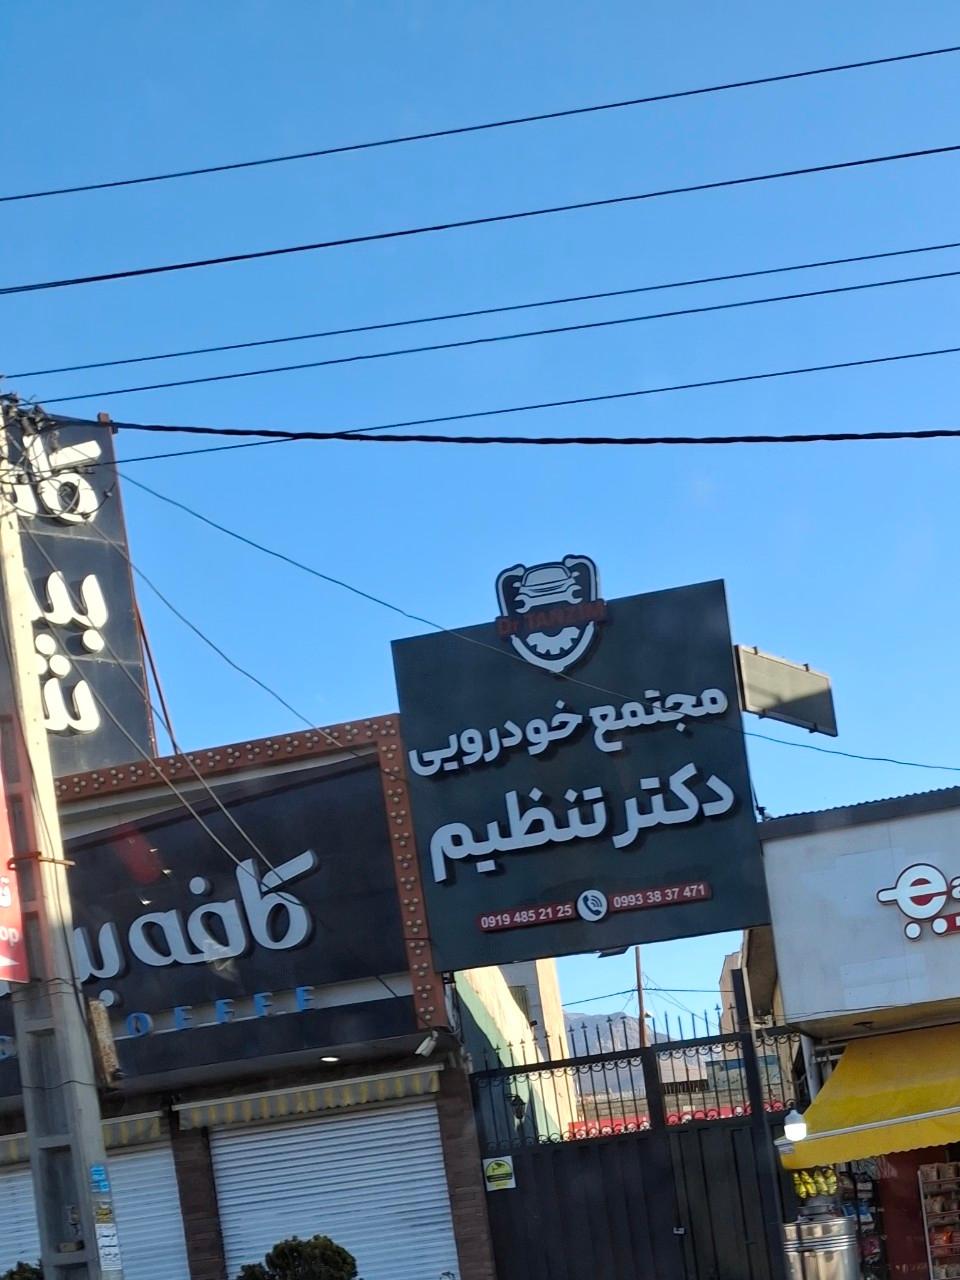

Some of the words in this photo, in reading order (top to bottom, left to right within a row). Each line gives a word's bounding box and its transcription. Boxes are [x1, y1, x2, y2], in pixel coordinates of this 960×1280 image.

[407, 699, 583, 777] خودرویی
[589, 688, 728, 753] مجتمع
[429, 785, 607, 884] تنظیم
[612, 762, 735, 849] دکتر
[481, 913, 510, 929] 0919
[513, 910, 536, 924] 485
[539, 908, 553, 921] 21
[556, 904, 572, 918] 25
[613, 893, 643, 908] 0993
[646, 890, 662, 904] 38
[664, 887, 679, 901] 37
[683, 884, 706, 899] 471
